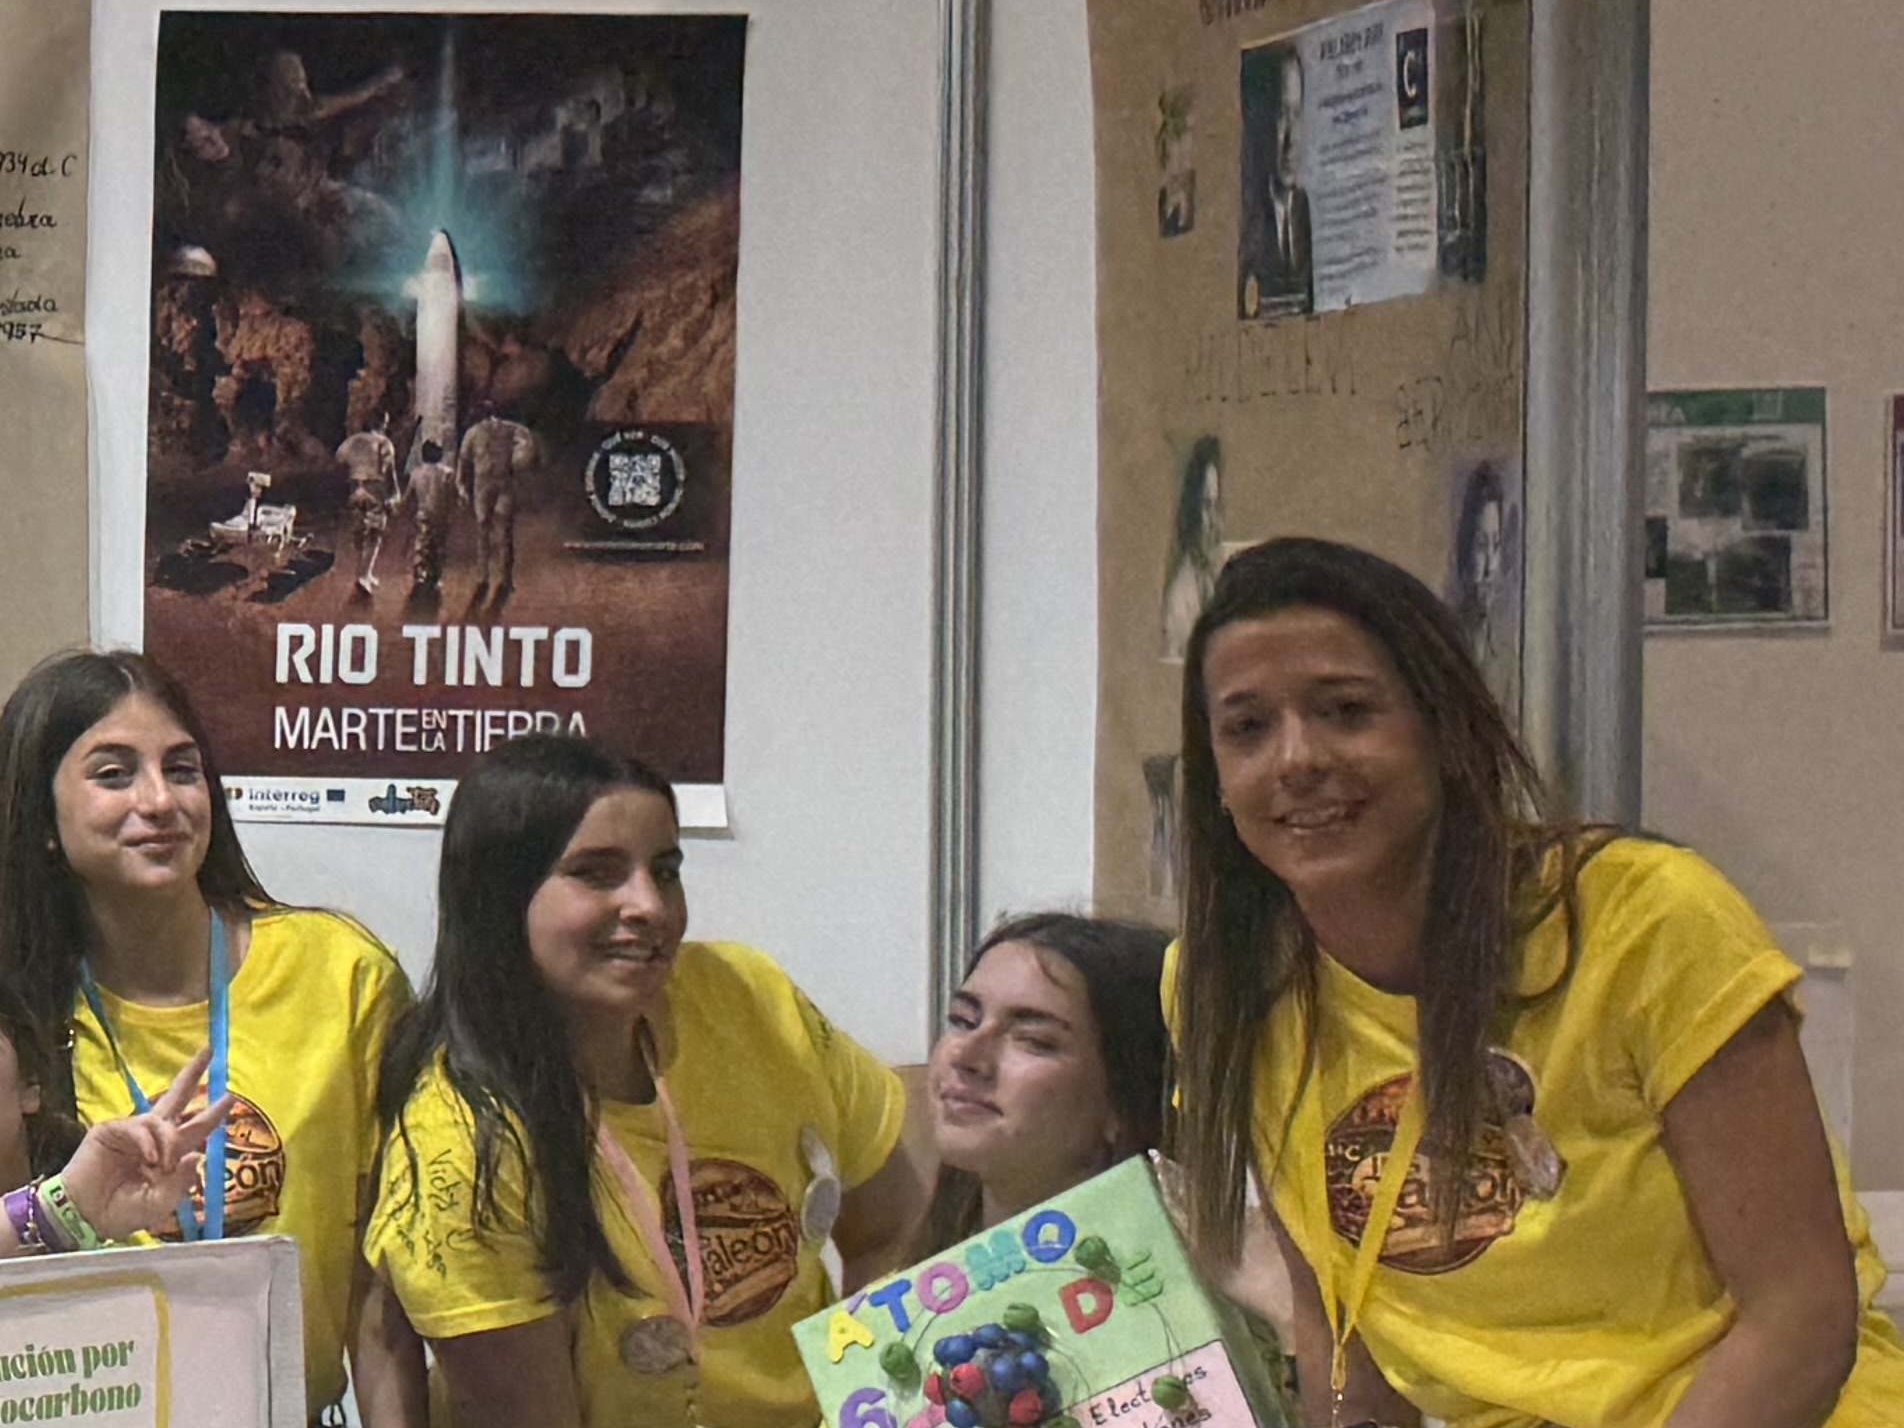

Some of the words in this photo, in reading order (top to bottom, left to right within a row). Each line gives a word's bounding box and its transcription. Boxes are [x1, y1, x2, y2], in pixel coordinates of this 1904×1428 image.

[275, 622, 378, 685] RIO
[402, 624, 594, 689] TINTO
[274, 706, 417, 752] MARTE
[423, 710, 446, 729] EN
[1059, 1250, 1165, 1334] DE
[82, 1339, 135, 1378] por
